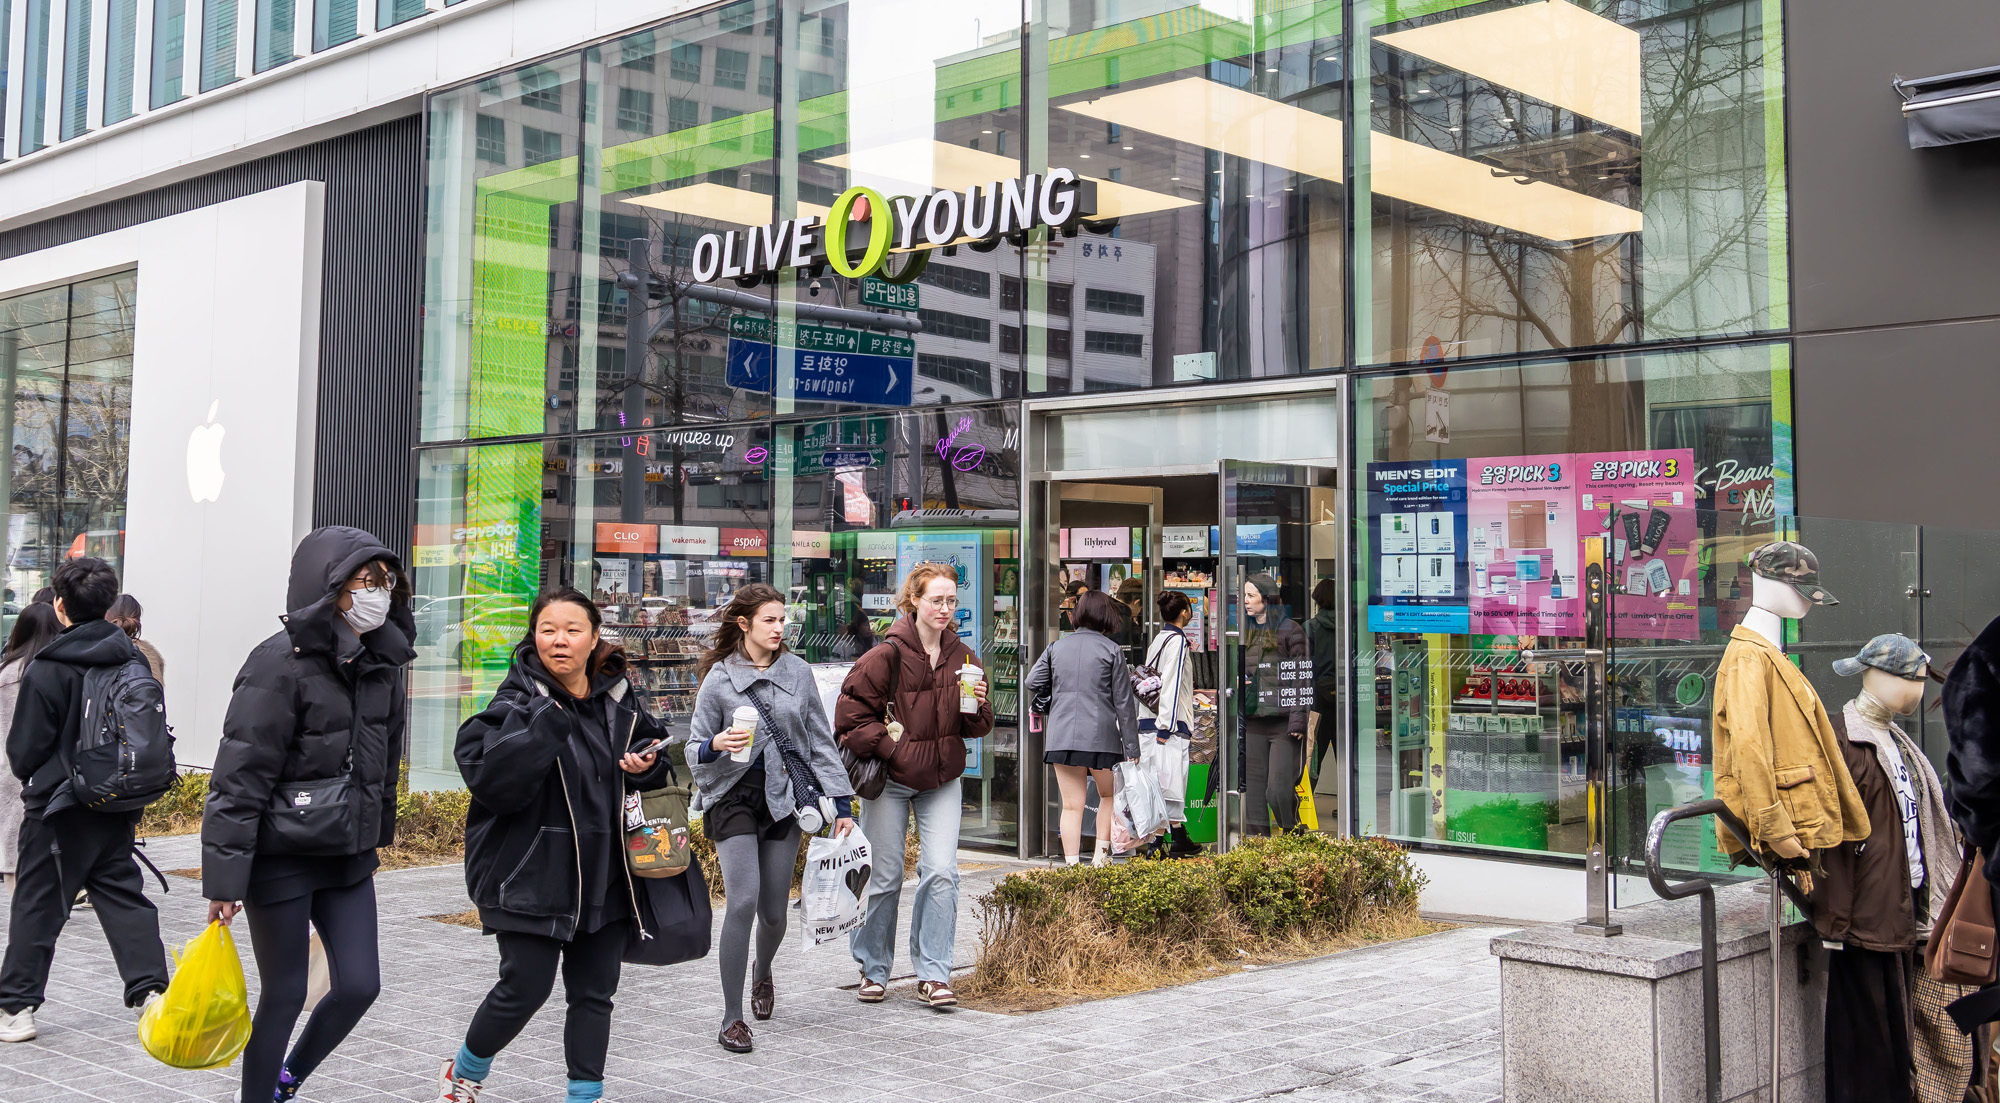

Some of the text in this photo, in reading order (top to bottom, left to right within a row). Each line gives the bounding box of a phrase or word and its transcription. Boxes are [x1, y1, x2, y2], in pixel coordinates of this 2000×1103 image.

[692, 215, 820, 284] OLIVE
[896, 167, 1082, 249] YOUNG
[715, 433, 734, 454] up
[934, 415, 974, 460] Beauty
[1375, 467, 1458, 481] MEN'S EDIT
[1547, 463, 1561, 483] 3
[1664, 458, 1678, 478] 3
[1383, 480, 1449, 496] Special Price
[613, 531, 640, 541] CLIO
[671, 536, 707, 545] wakemake
[733, 535, 762, 550] espoir
[1084, 537, 1117, 549] lilybyred
[1473, 610, 1483, 618] Up
[1516, 610, 1540, 618] Limited
[1280, 660, 1313, 670] OPEN 10:00
[1280, 671, 1313, 680] CLOSE 23:00
[1281, 687, 1314, 697] OPEN 10:00
[1281, 696, 1314, 707] CLOSE 23:00
[1190, 799, 1203, 808] HOT
[1455, 830, 1477, 844] ISSUE
[815, 910, 867, 936] NEW WAVES OF
